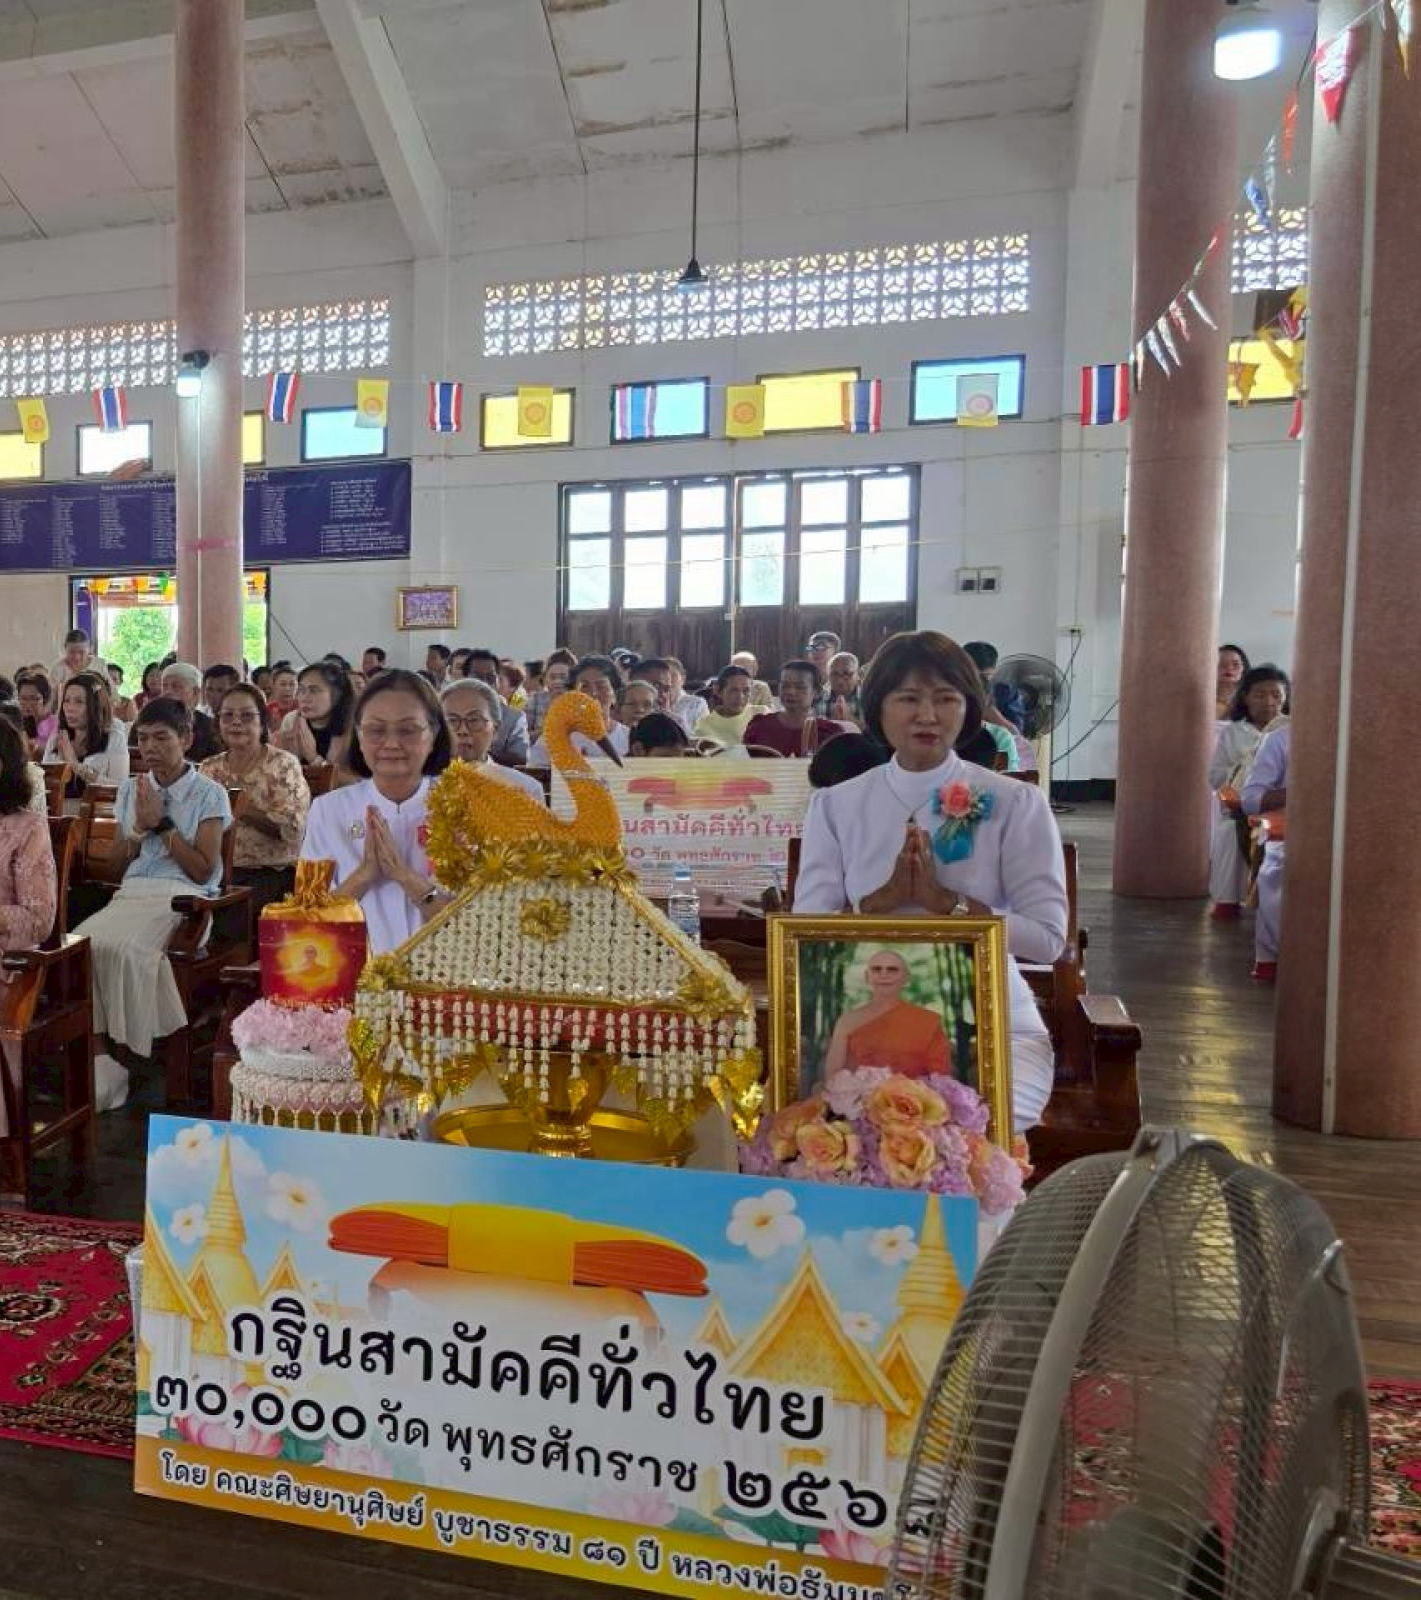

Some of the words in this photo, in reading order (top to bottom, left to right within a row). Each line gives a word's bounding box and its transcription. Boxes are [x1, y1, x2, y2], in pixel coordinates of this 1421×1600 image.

[230, 1296, 824, 1441] กฐินสามัคคีทั่วไทย
[155, 1374, 367, 1441] ๓๐,๐๐๐
[377, 1397, 429, 1448] วัด
[442, 1422, 698, 1492] พุทธศักราช
[161, 1451, 207, 1486] โดย
[216, 1474, 424, 1526] คณะศิษยานุศิษย์
[434, 1511, 571, 1555] บูชาธรรม
[583, 1540, 626, 1566] ๘๑
[639, 1538, 660, 1570] ปี
